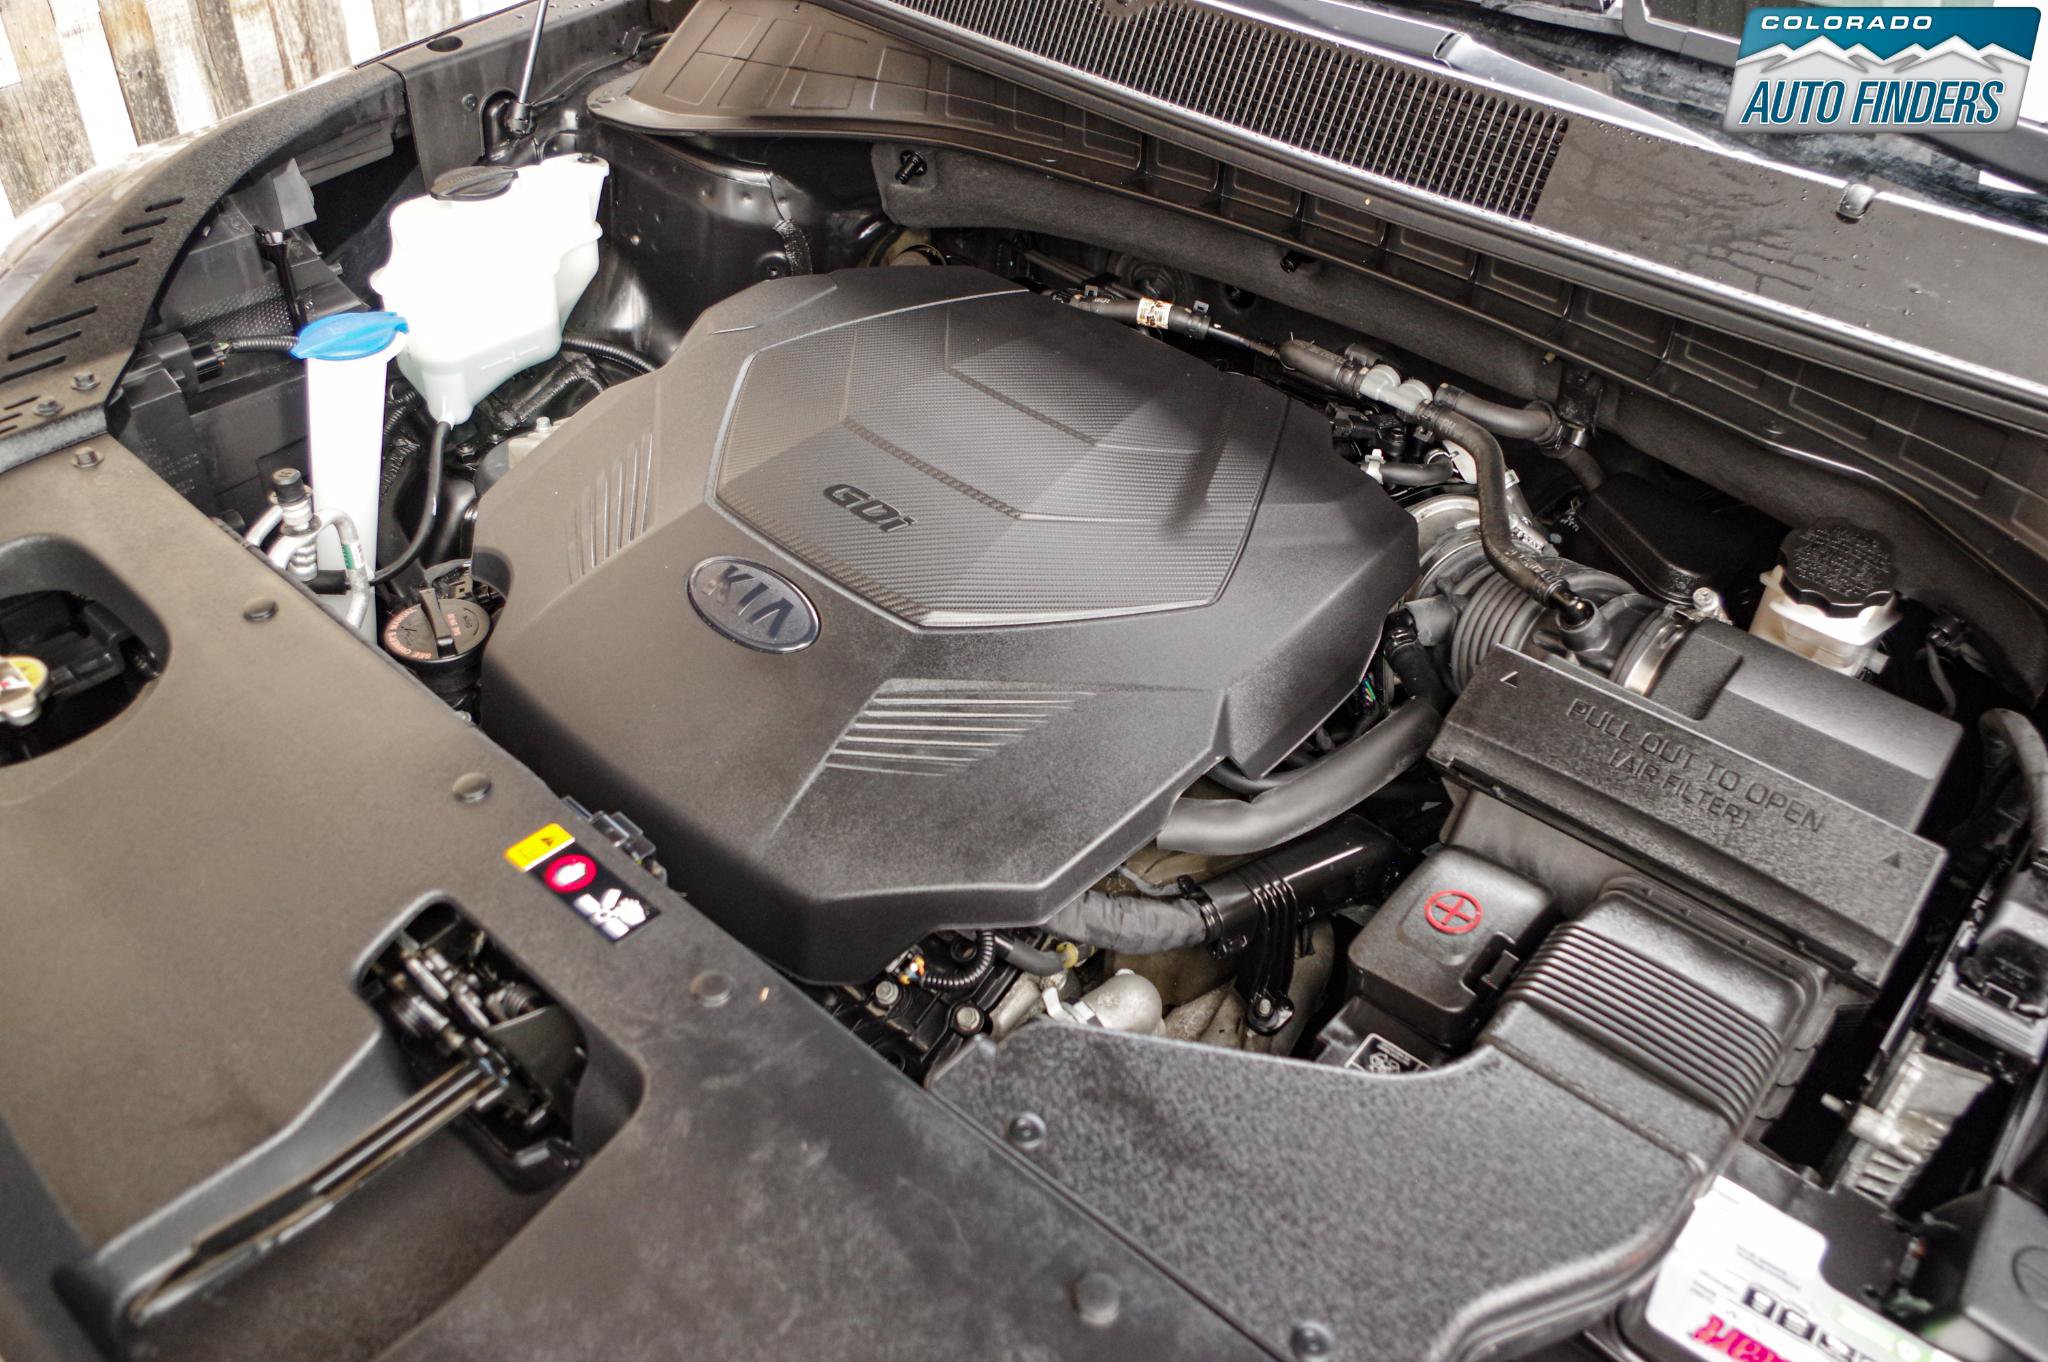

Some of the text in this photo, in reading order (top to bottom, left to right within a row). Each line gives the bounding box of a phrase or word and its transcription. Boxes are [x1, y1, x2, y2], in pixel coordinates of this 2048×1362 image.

[823, 484, 917, 533] GDi
[703, 564, 794, 639] KIA
[1566, 698, 1826, 833] PULL OUT TO OPEN
